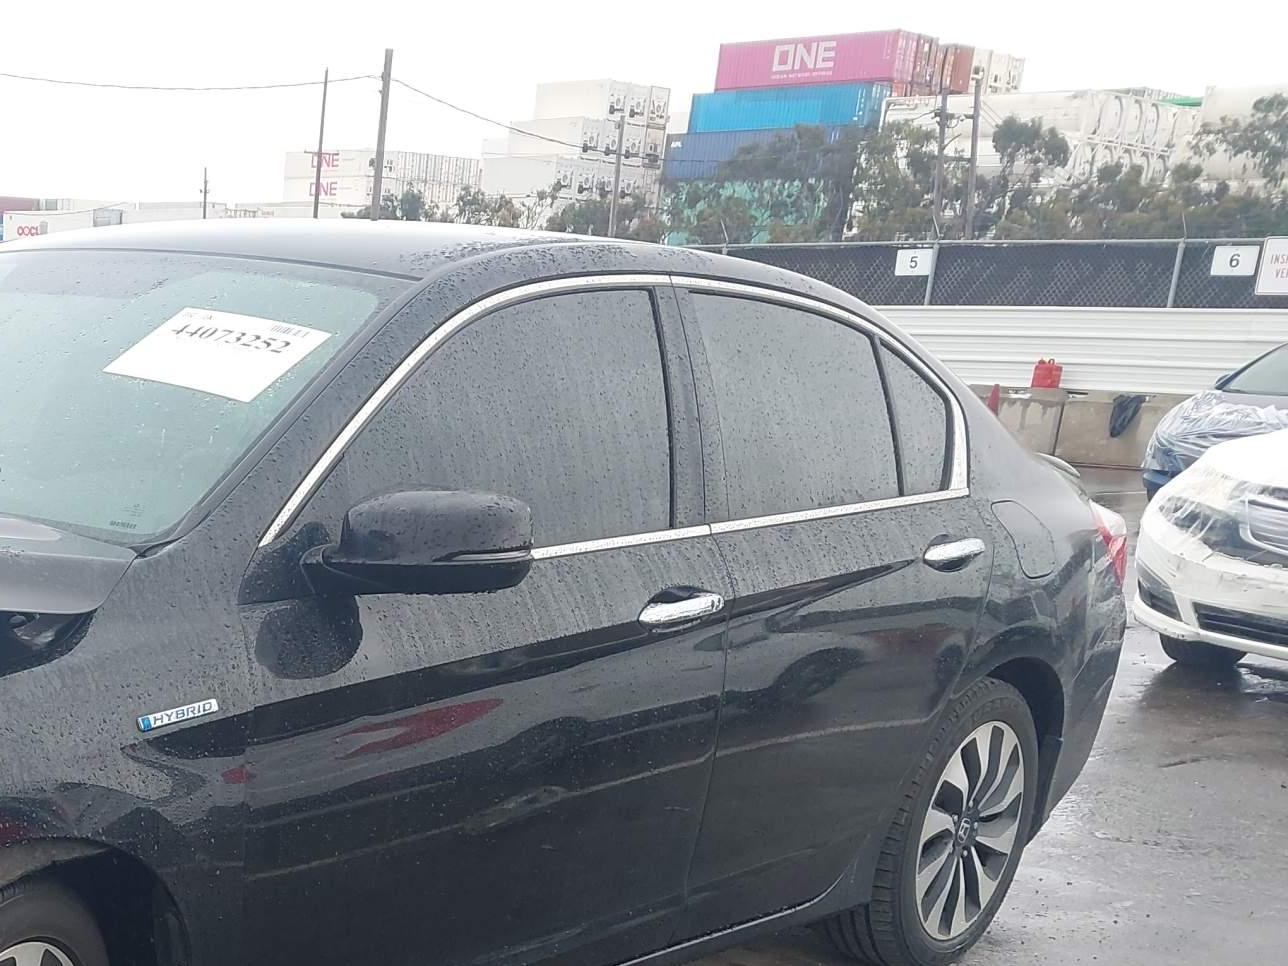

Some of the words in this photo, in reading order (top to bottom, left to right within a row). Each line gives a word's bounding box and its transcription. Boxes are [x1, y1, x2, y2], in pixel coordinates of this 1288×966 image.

[772, 40, 837, 72] ONE
[311, 153, 340, 168] ONE
[309, 181, 338, 197] ONE
[909, 255, 919, 269] 5
[1229, 253, 1241, 268] 6
[171, 323, 292, 354] 44073252
[152, 701, 214, 726] HYBRID
